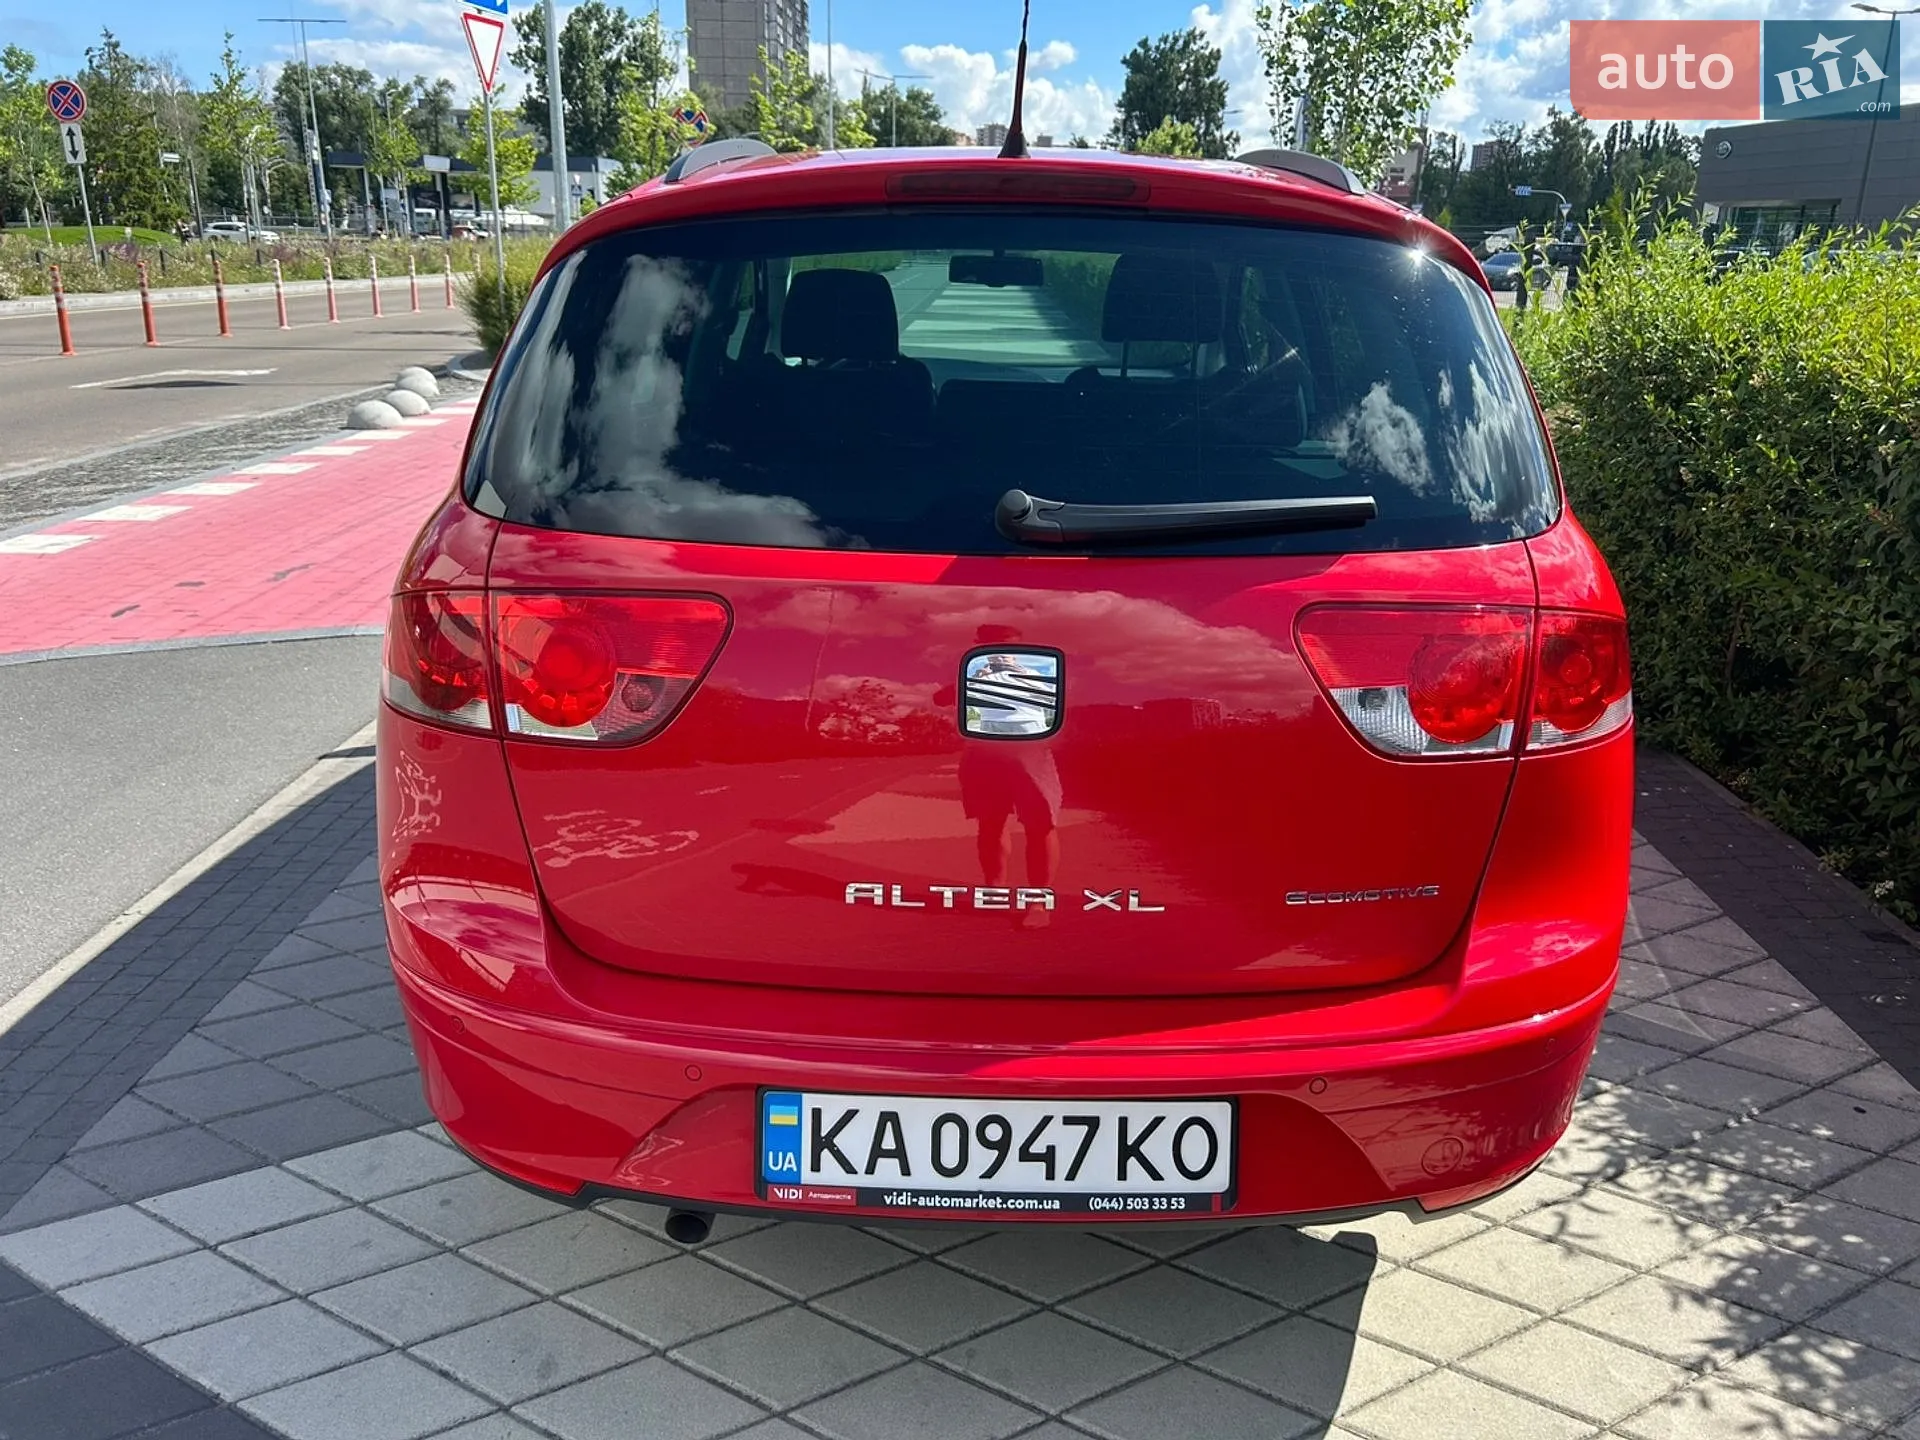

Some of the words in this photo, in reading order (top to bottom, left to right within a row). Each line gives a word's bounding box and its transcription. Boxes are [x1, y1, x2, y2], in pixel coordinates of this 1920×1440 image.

[845, 882, 1054, 910] ALTEA
[1082, 888, 1165, 912] XL
[768, 1151, 797, 1172] UA
[773, 1187, 803, 1200] VIDI
[884, 1193, 1061, 1210] vidi-automarket.com.ua
[1088, 1197, 1124, 1211] (044)
[1126, 1198, 1149, 1210] 503
[1151, 1198, 1167, 1210] 33
[1170, 1198, 1186, 1210] 53
